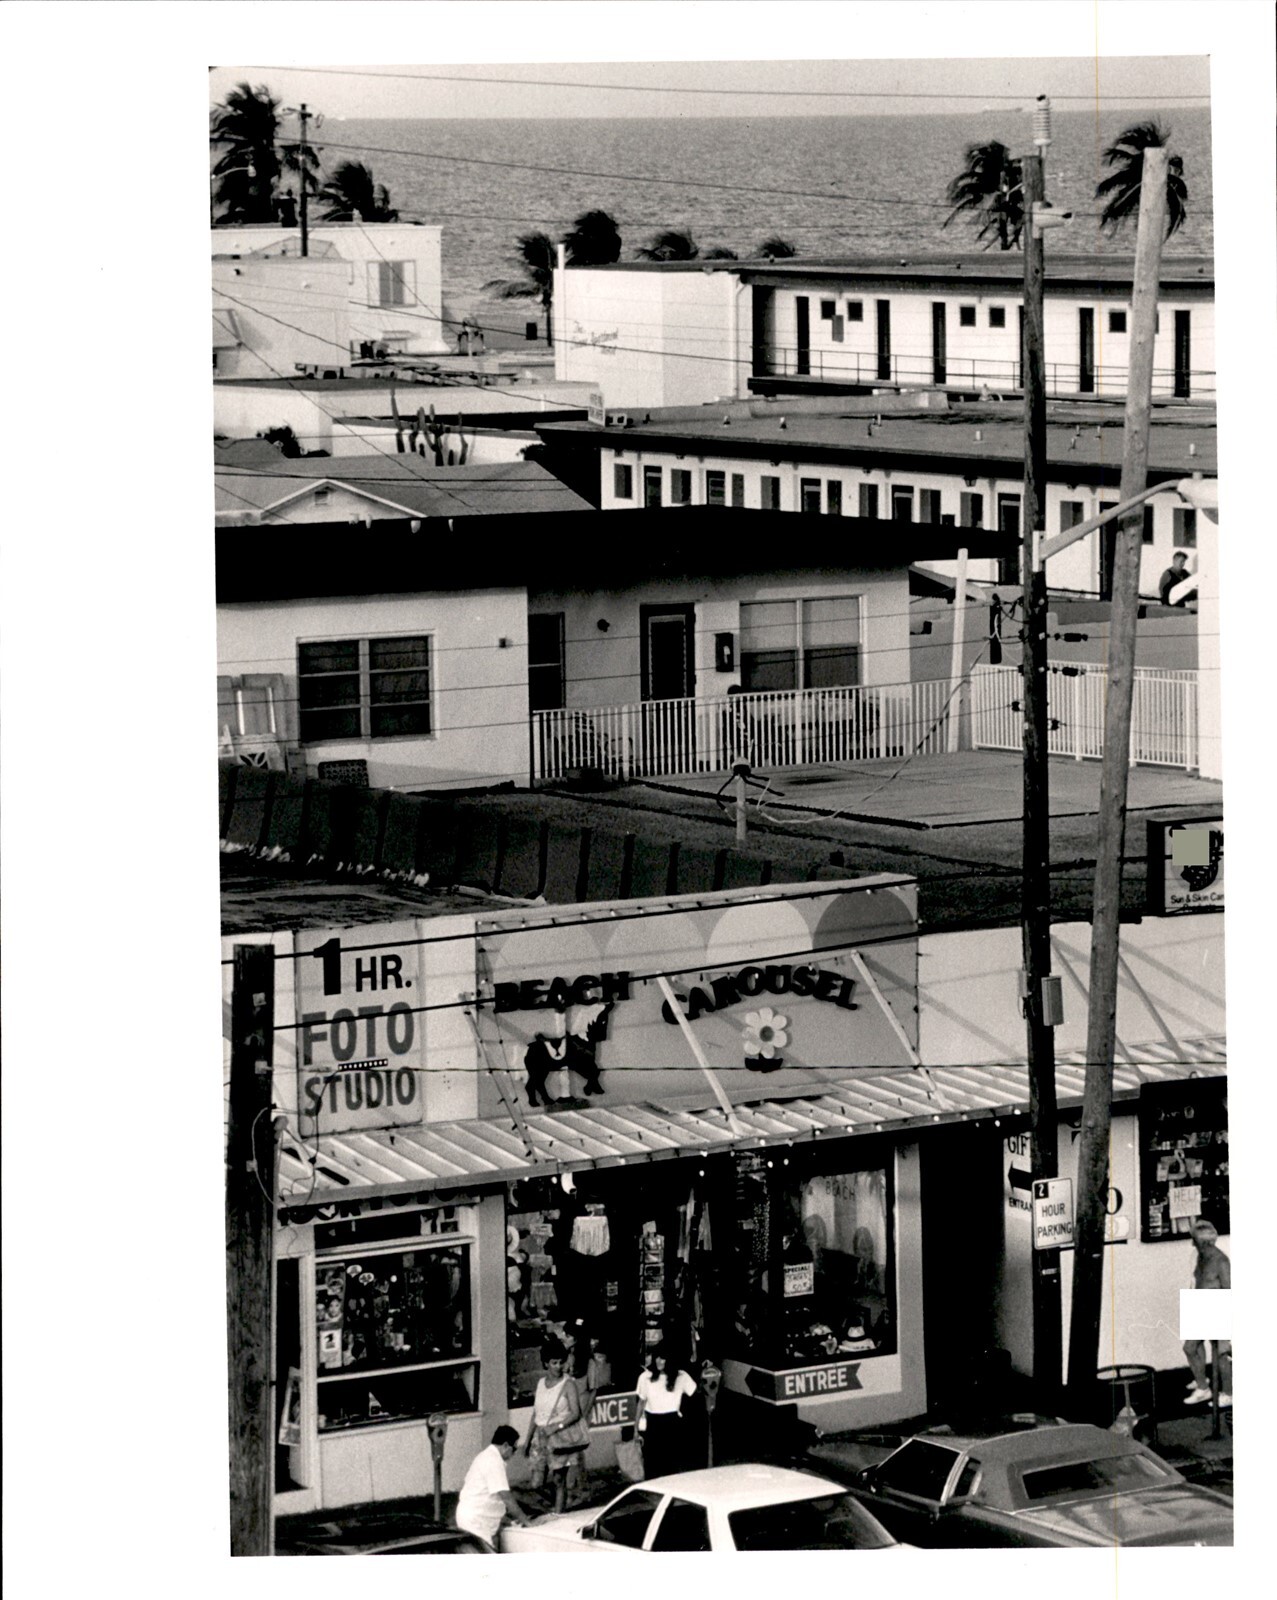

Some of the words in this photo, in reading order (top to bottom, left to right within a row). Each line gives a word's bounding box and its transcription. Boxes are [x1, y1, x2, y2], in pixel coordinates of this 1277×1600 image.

[1170, 894, 1184, 904] Sun
[1186, 894, 1191, 903] &
[1192, 893, 1209, 903] Skin
[1211, 892, 1224, 902] Car
[313, 938, 341, 996] 1
[355, 953, 412, 992] HR.
[493, 971, 630, 1014] BEACH
[661, 964, 859, 1025] CAROUSEL
[302, 1001, 415, 1066] FOTO
[304, 1066, 416, 1117] STUDIO
[1007, 1132, 1031, 1156] GIF
[1037, 1183, 1045, 1197] 2
[1008, 1197, 1032, 1213] ENTRAN
[1041, 1202, 1066, 1217] HOUR
[1037, 1221, 1073, 1238] PARKING
[590, 1398, 629, 1425] ANCE
